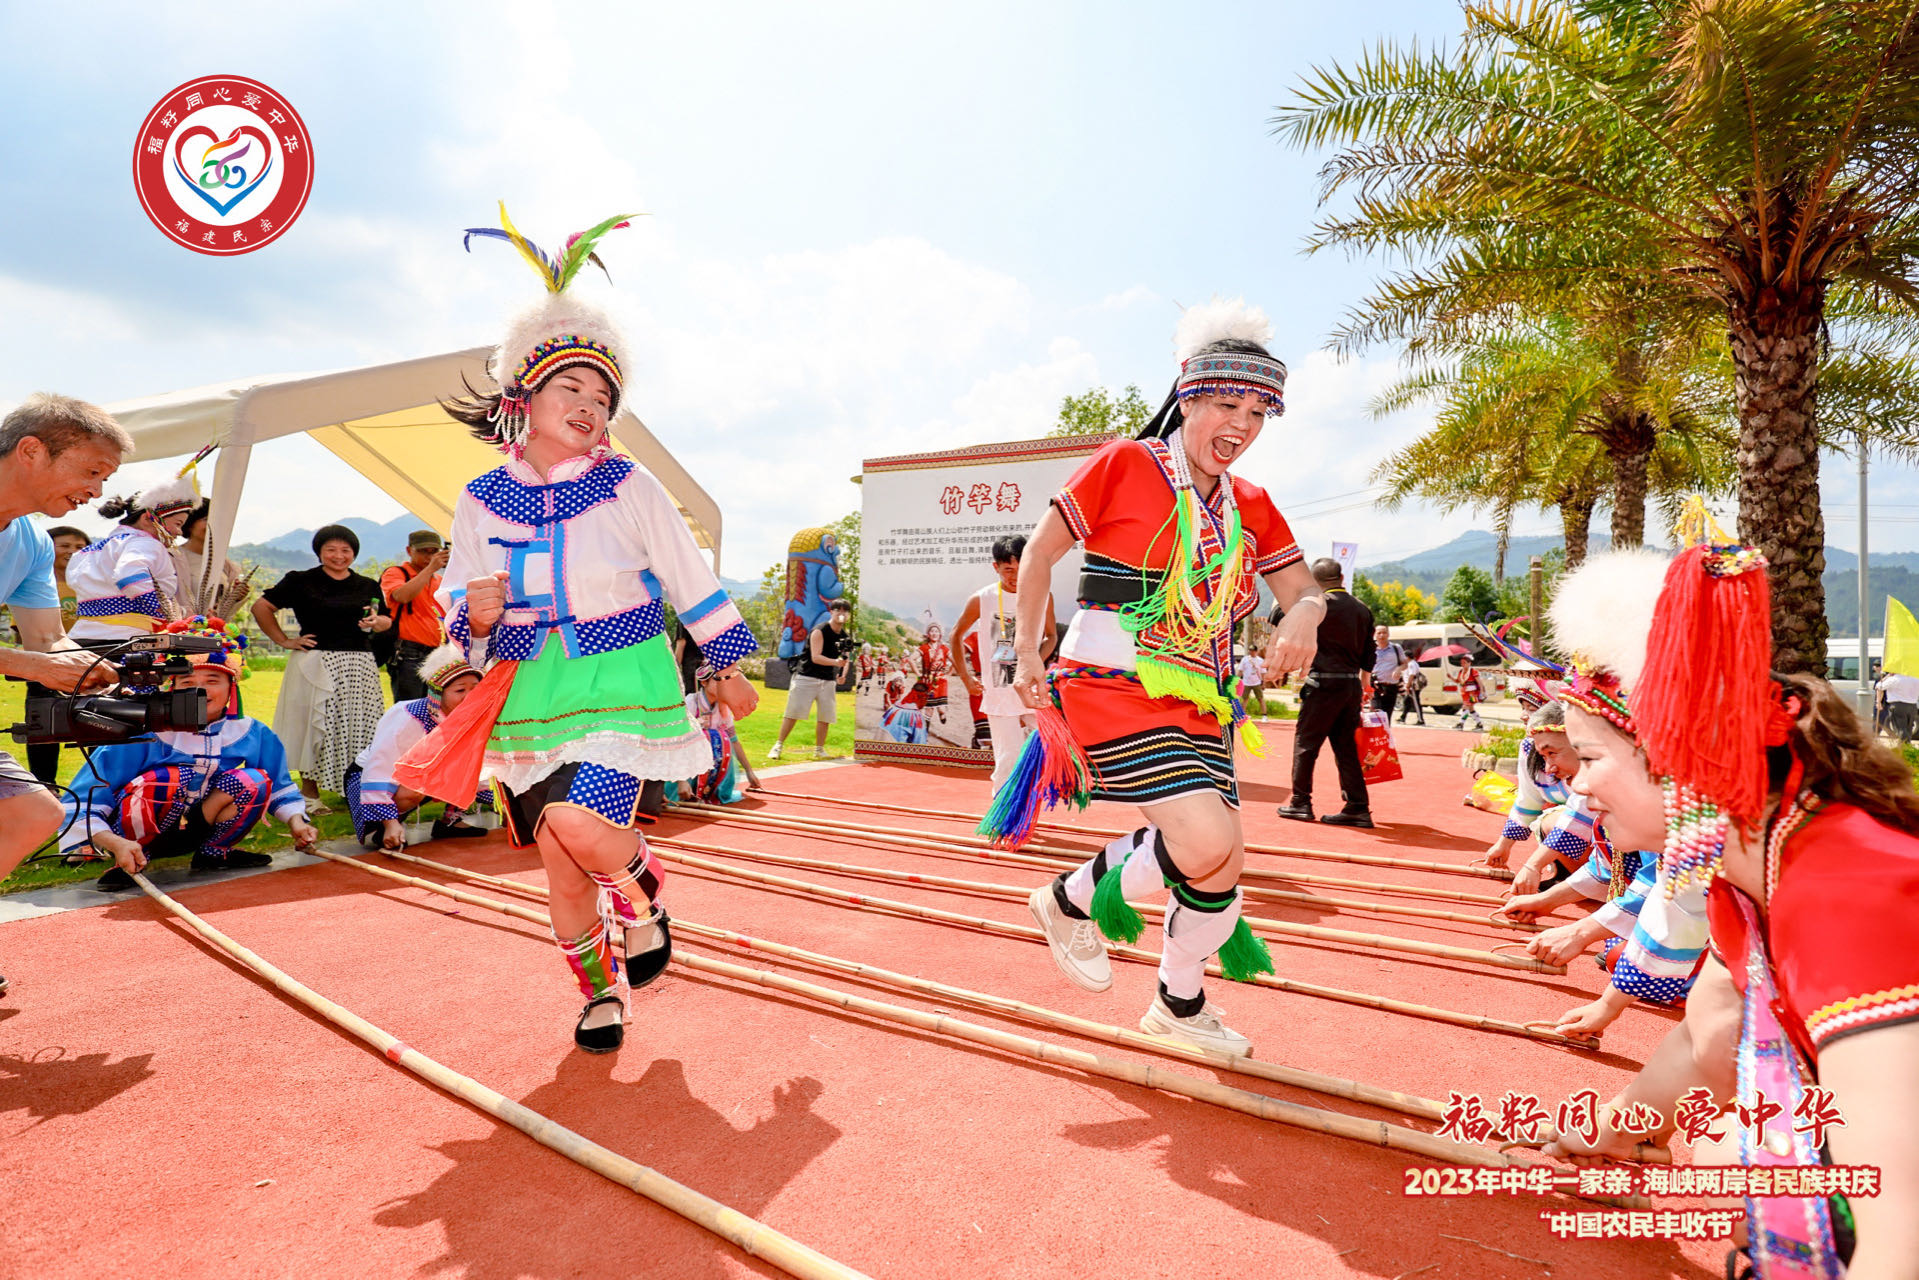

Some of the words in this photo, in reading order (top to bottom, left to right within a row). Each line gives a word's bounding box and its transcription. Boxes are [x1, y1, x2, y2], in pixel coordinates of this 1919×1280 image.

[939, 481, 1022, 516] 竹竿舞
[87, 720, 113, 731] SONY
